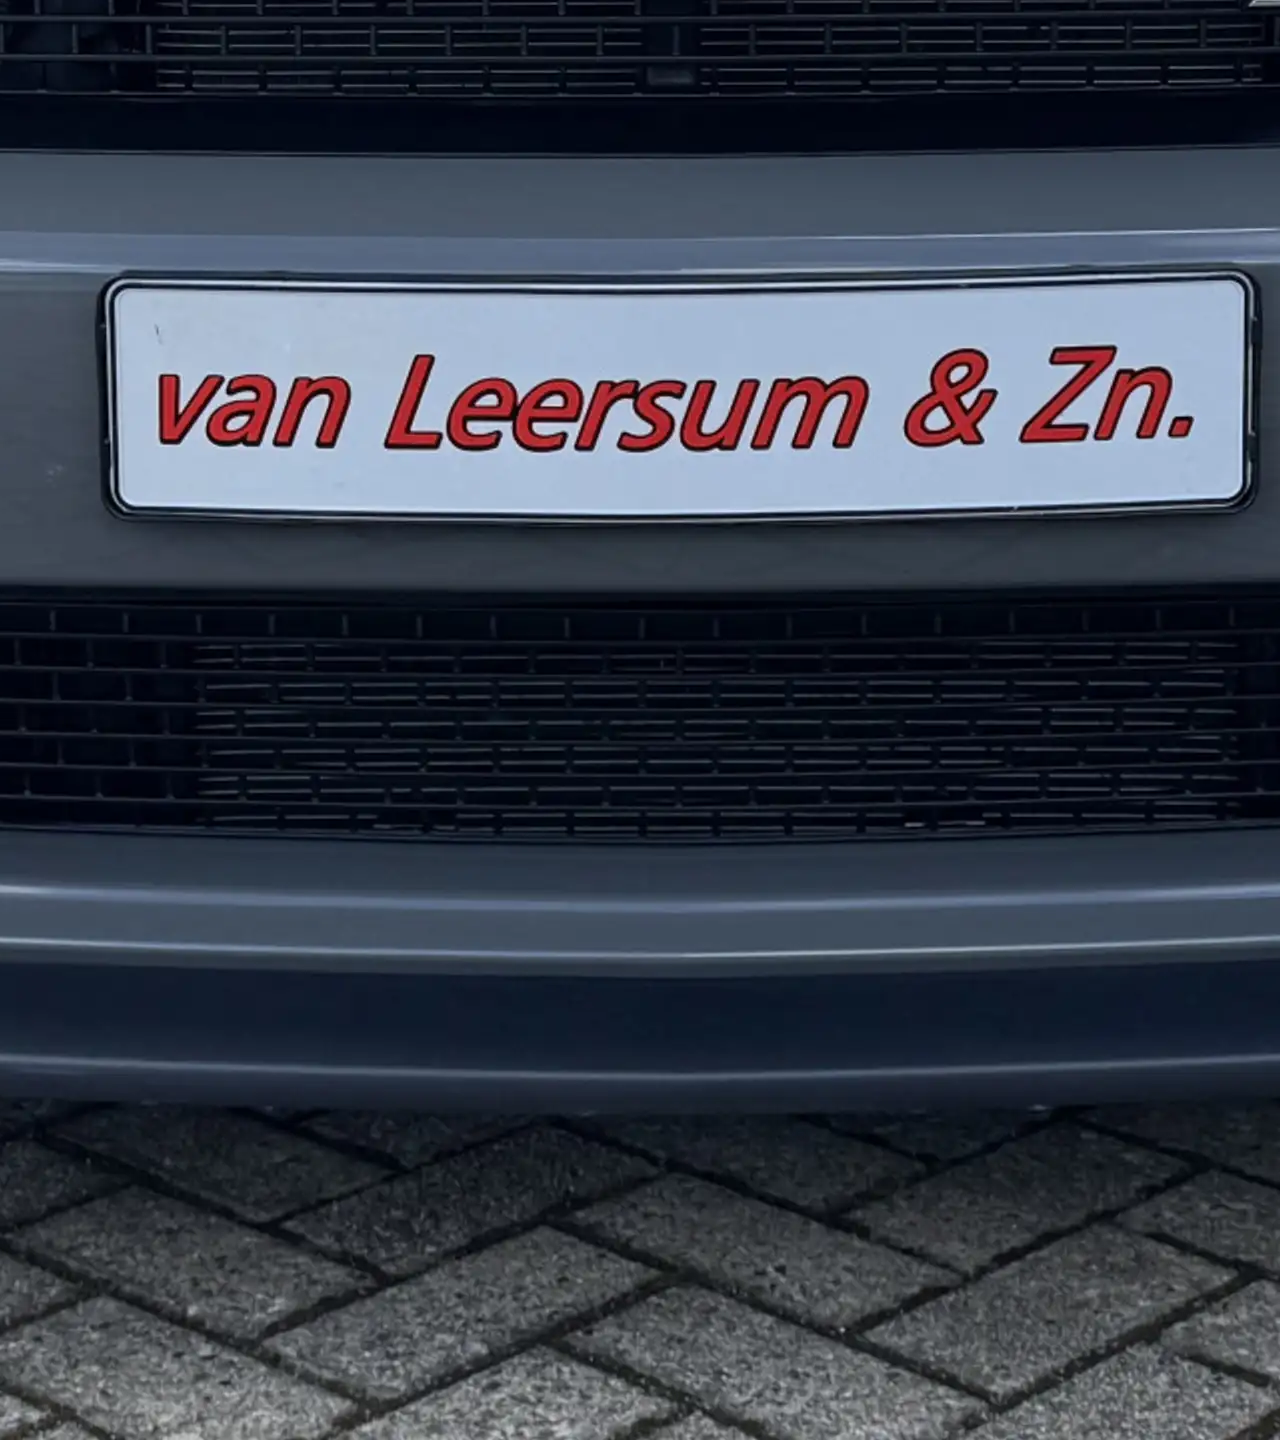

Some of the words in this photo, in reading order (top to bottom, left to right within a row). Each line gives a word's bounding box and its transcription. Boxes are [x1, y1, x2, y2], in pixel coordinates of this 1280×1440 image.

[156, 370, 352, 449] van
[383, 353, 870, 453] Leersum
[903, 348, 997, 447] &
[1020, 344, 1196, 445] Zn.
